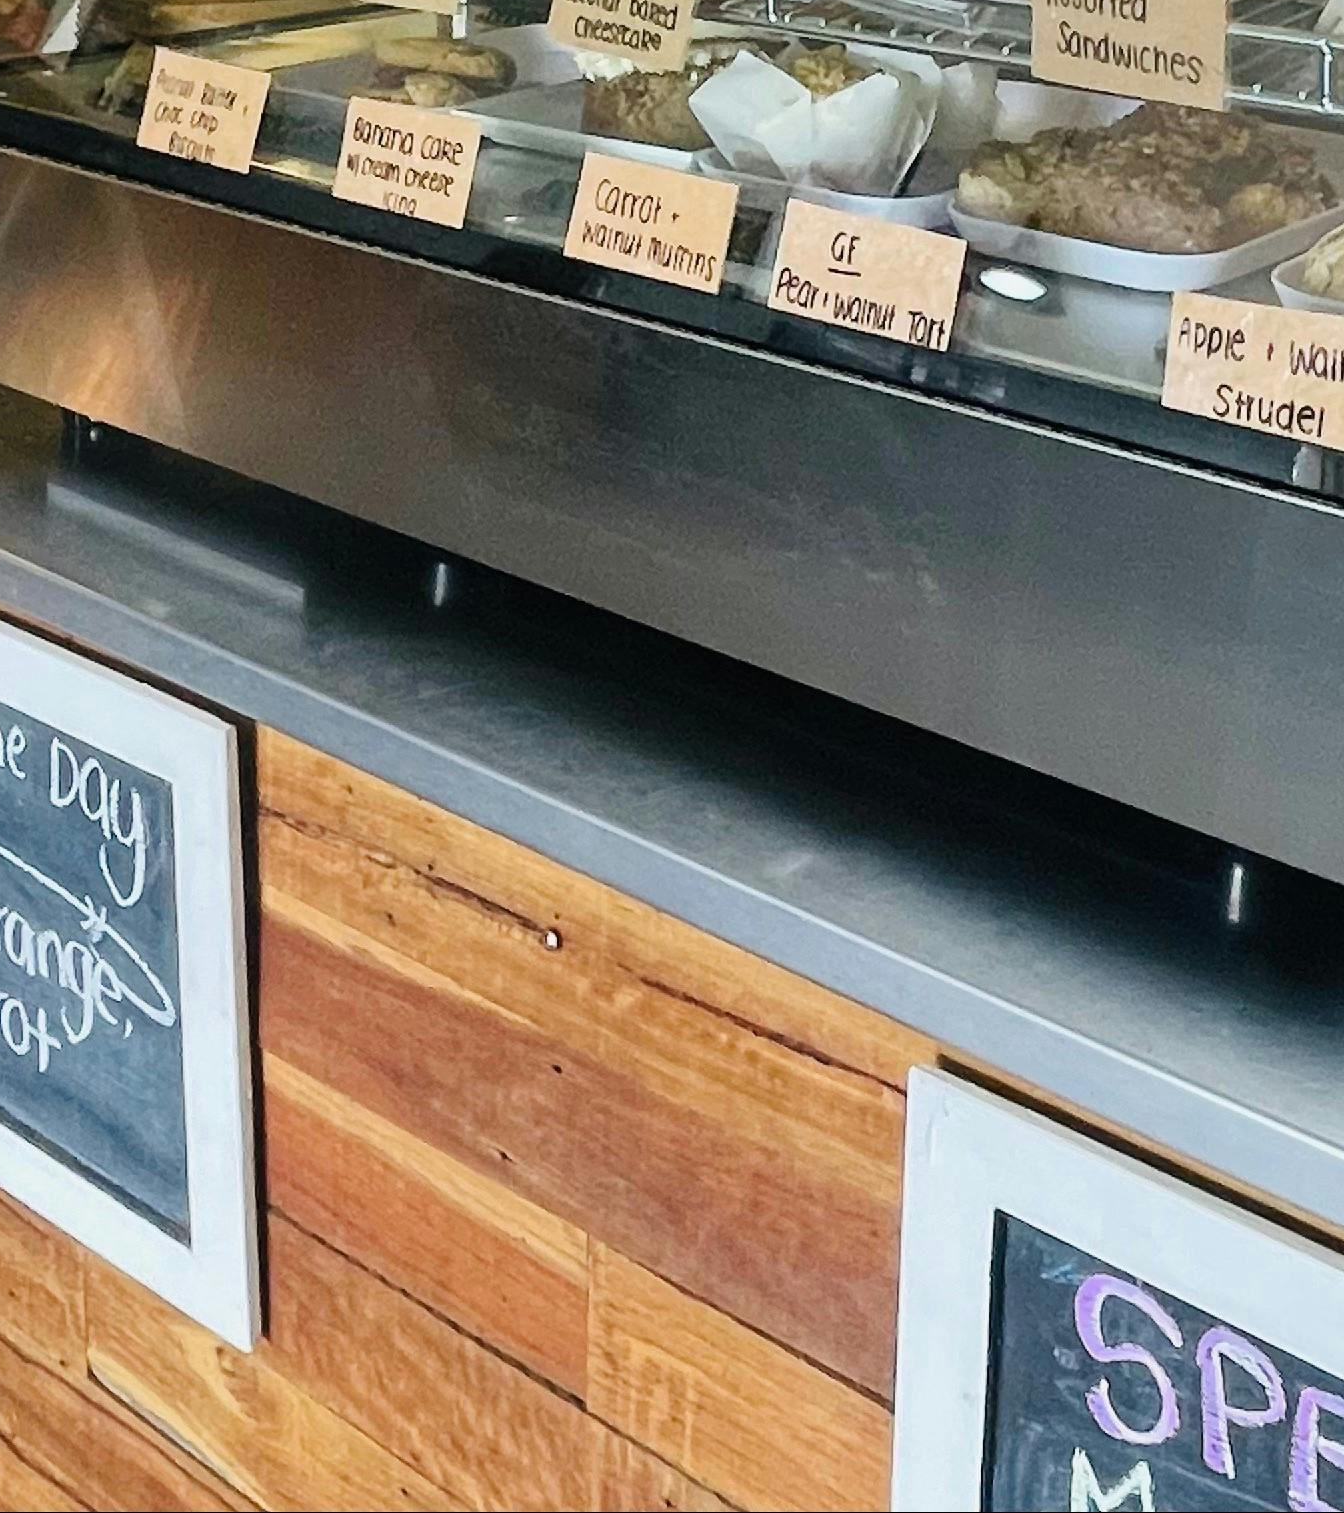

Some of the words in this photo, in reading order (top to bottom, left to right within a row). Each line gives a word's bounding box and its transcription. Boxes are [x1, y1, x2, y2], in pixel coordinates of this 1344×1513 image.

[1057, 20, 1204, 85] Sandwiches
[353, 117, 414, 157] Banana
[594, 178, 663, 225] Carrot
[830, 230, 861, 266] GF
[776, 266, 815, 309] Pear
[1177, 316, 1248, 364] Apple
[1212, 383, 1327, 439] Strudel
[49, 737, 146, 908] Day
